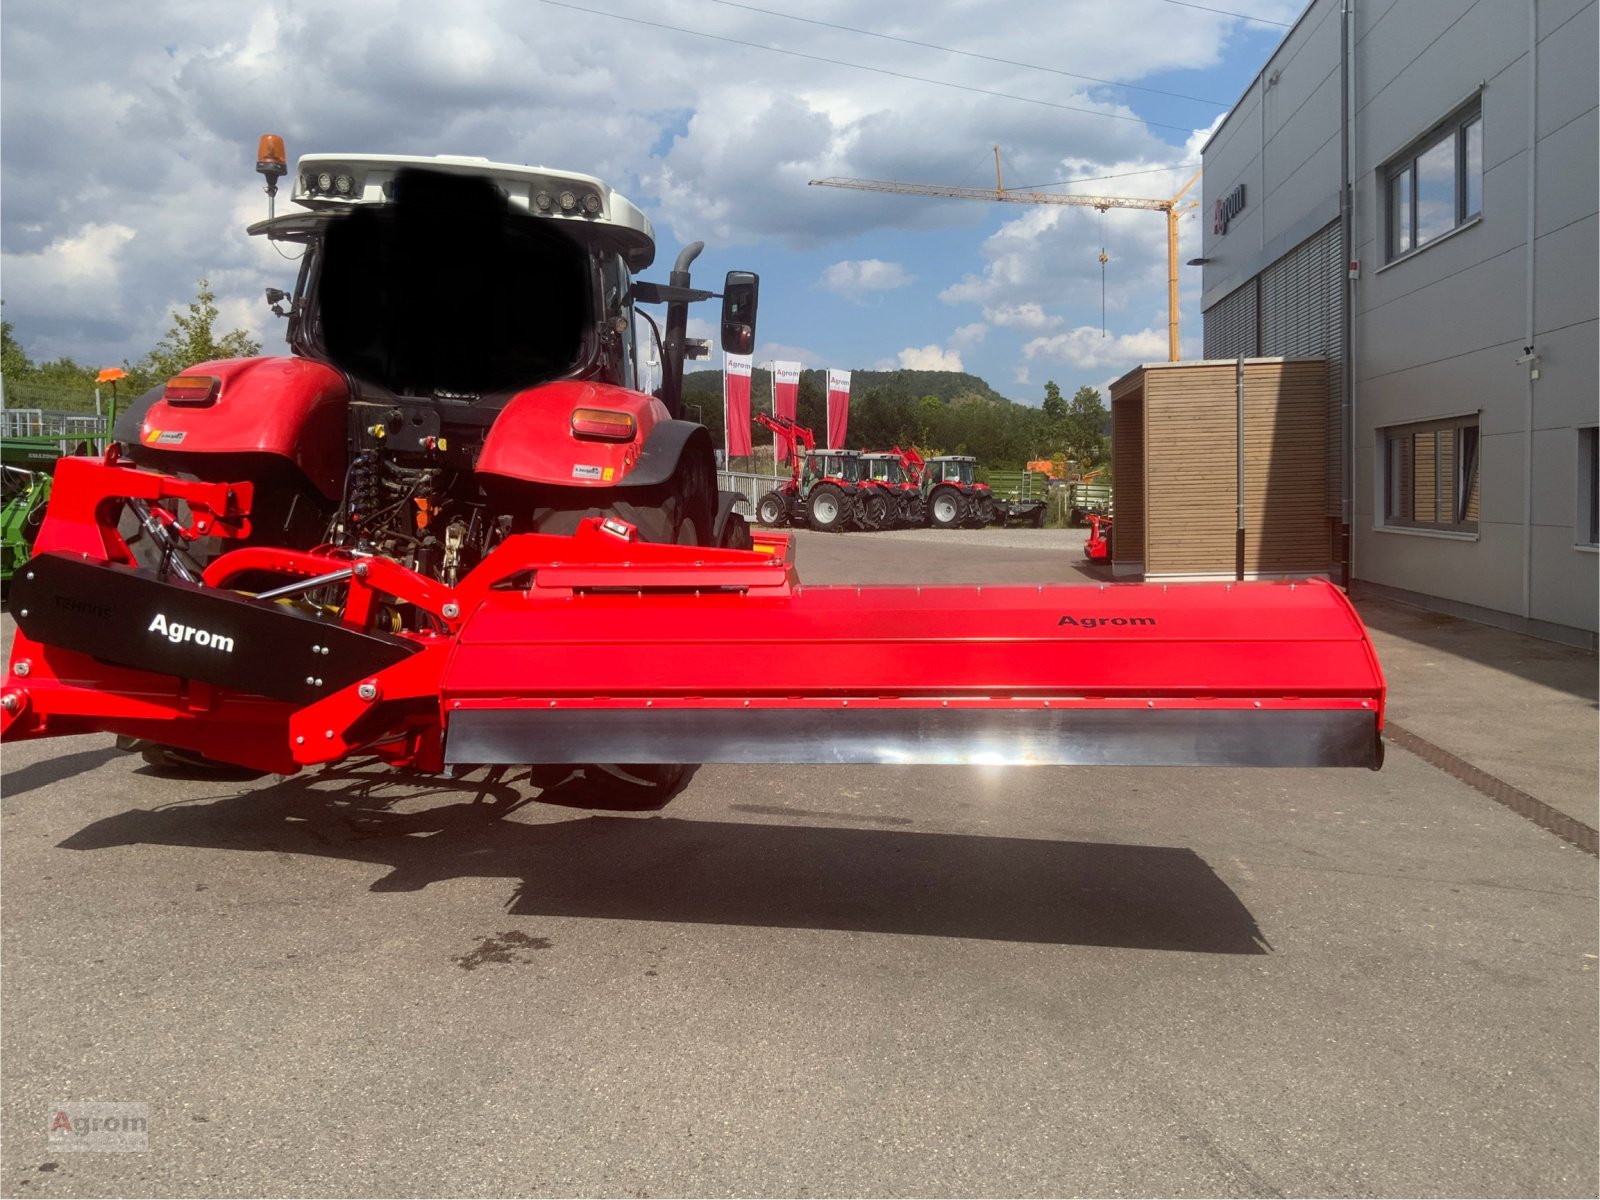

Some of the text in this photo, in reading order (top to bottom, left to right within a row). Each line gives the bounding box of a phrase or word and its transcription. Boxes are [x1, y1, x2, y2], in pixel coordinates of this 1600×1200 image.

[1214, 184, 1246, 236] Agrom
[728, 359, 751, 370] Agrom
[776, 369, 799, 378] Agrom
[830, 376, 849, 386] Agrom
[1057, 615, 1156, 628] Agrom
[148, 613, 235, 652] Agrom
